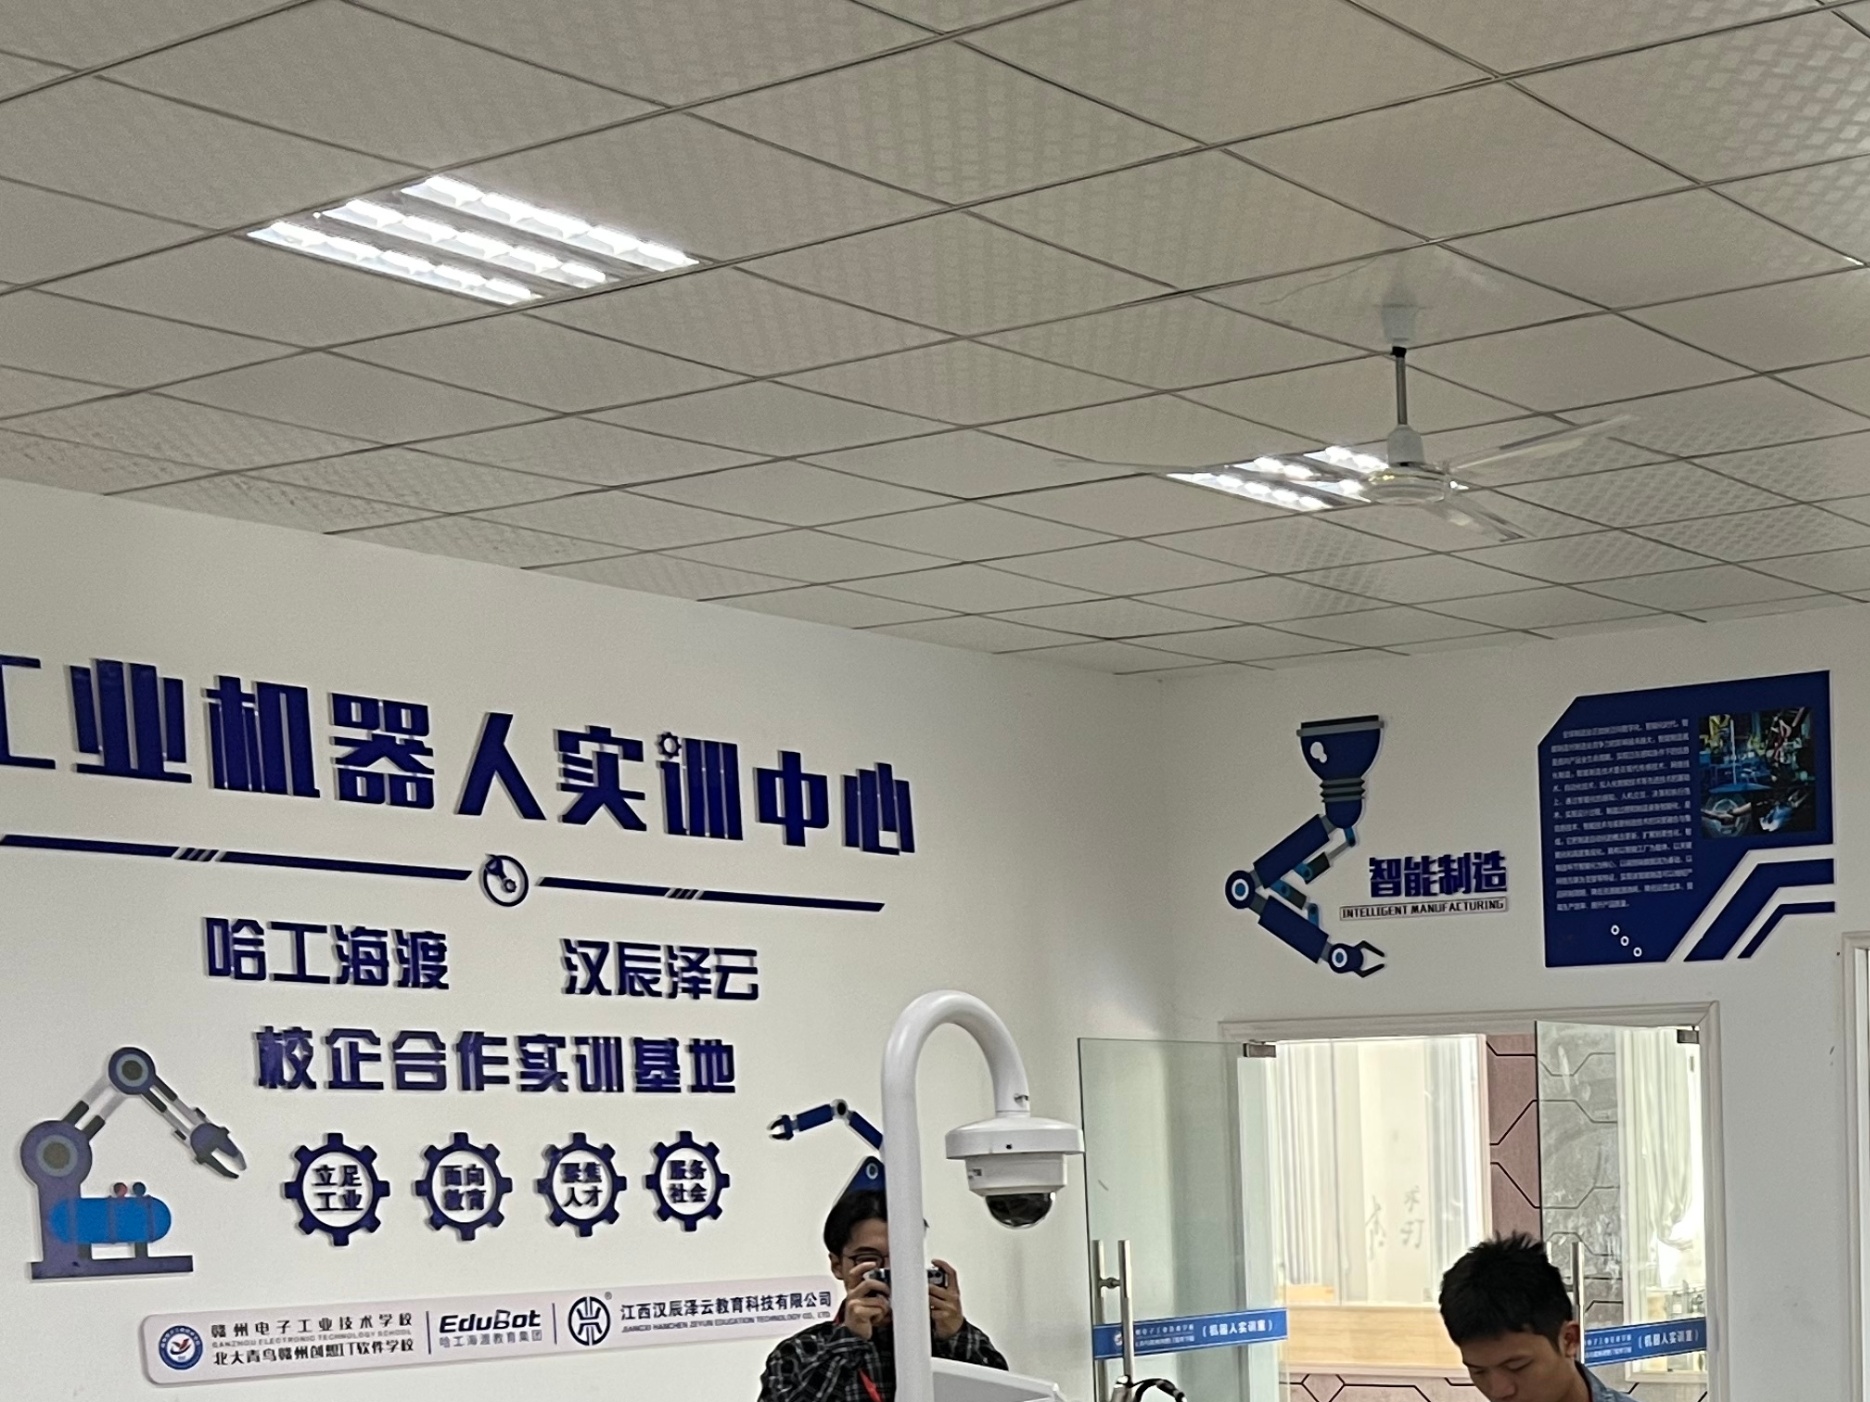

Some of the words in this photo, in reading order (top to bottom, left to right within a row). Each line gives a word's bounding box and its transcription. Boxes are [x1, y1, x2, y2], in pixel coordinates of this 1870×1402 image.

[1369, 850, 1507, 897] 智能制造
[1342, 905, 1408, 918] INTELLIGENT
[1411, 900, 1504, 914] MANUFACTURING
[205, 917, 450, 990] 哈工海渡
[561, 938, 760, 1000] 汉辰泽云
[256, 1026, 737, 1094] 校企合作实训基地
[313, 1165, 363, 1187] 立足
[314, 1190, 364, 1212] 工业
[563, 1186, 603, 1208] 人才
[667, 1183, 707, 1203] 社会
[620, 1291, 832, 1320] 江西汉辰泽云教育科技有限公司
[211, 1312, 413, 1338] 赣州电子工业技术学校
[439, 1309, 541, 1333] EduBot
